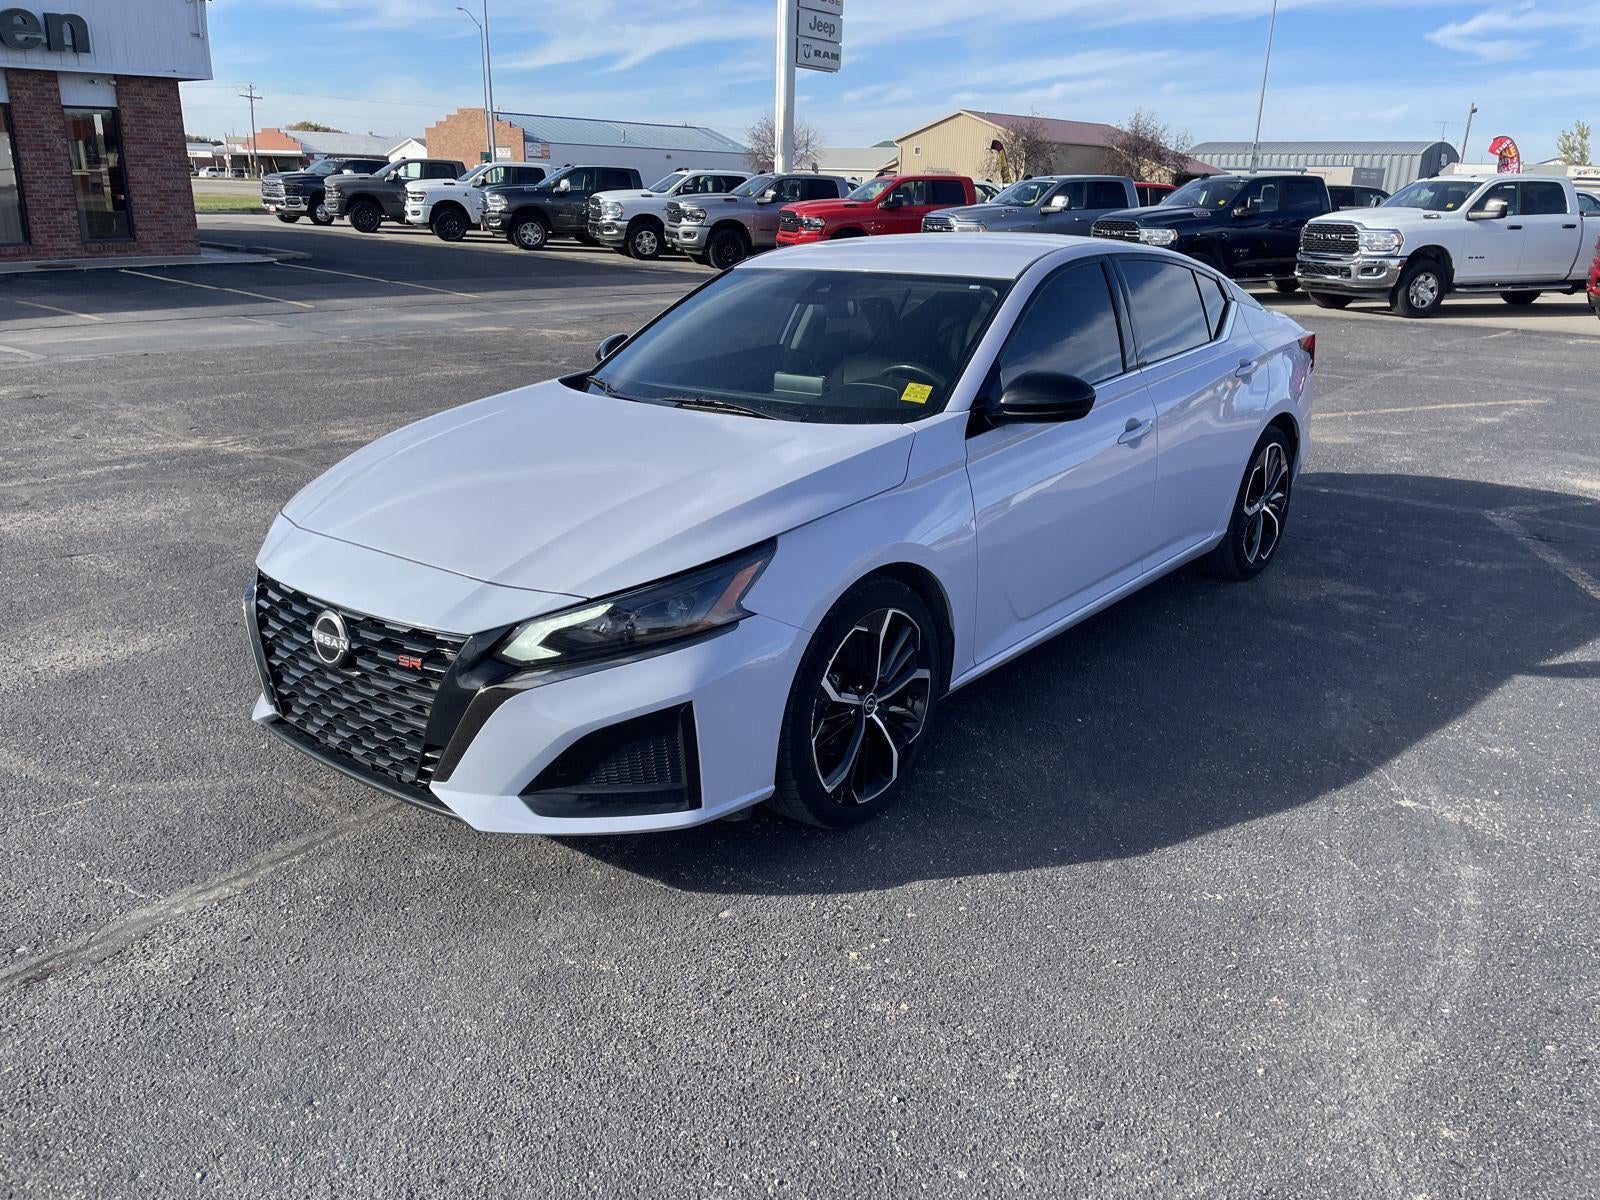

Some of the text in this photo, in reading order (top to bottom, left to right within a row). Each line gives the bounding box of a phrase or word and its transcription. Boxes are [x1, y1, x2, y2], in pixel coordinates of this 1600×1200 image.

[809, 15, 836, 37] Jeep
[814, 49, 840, 61] RAM
[398, 654, 422, 670] SR
